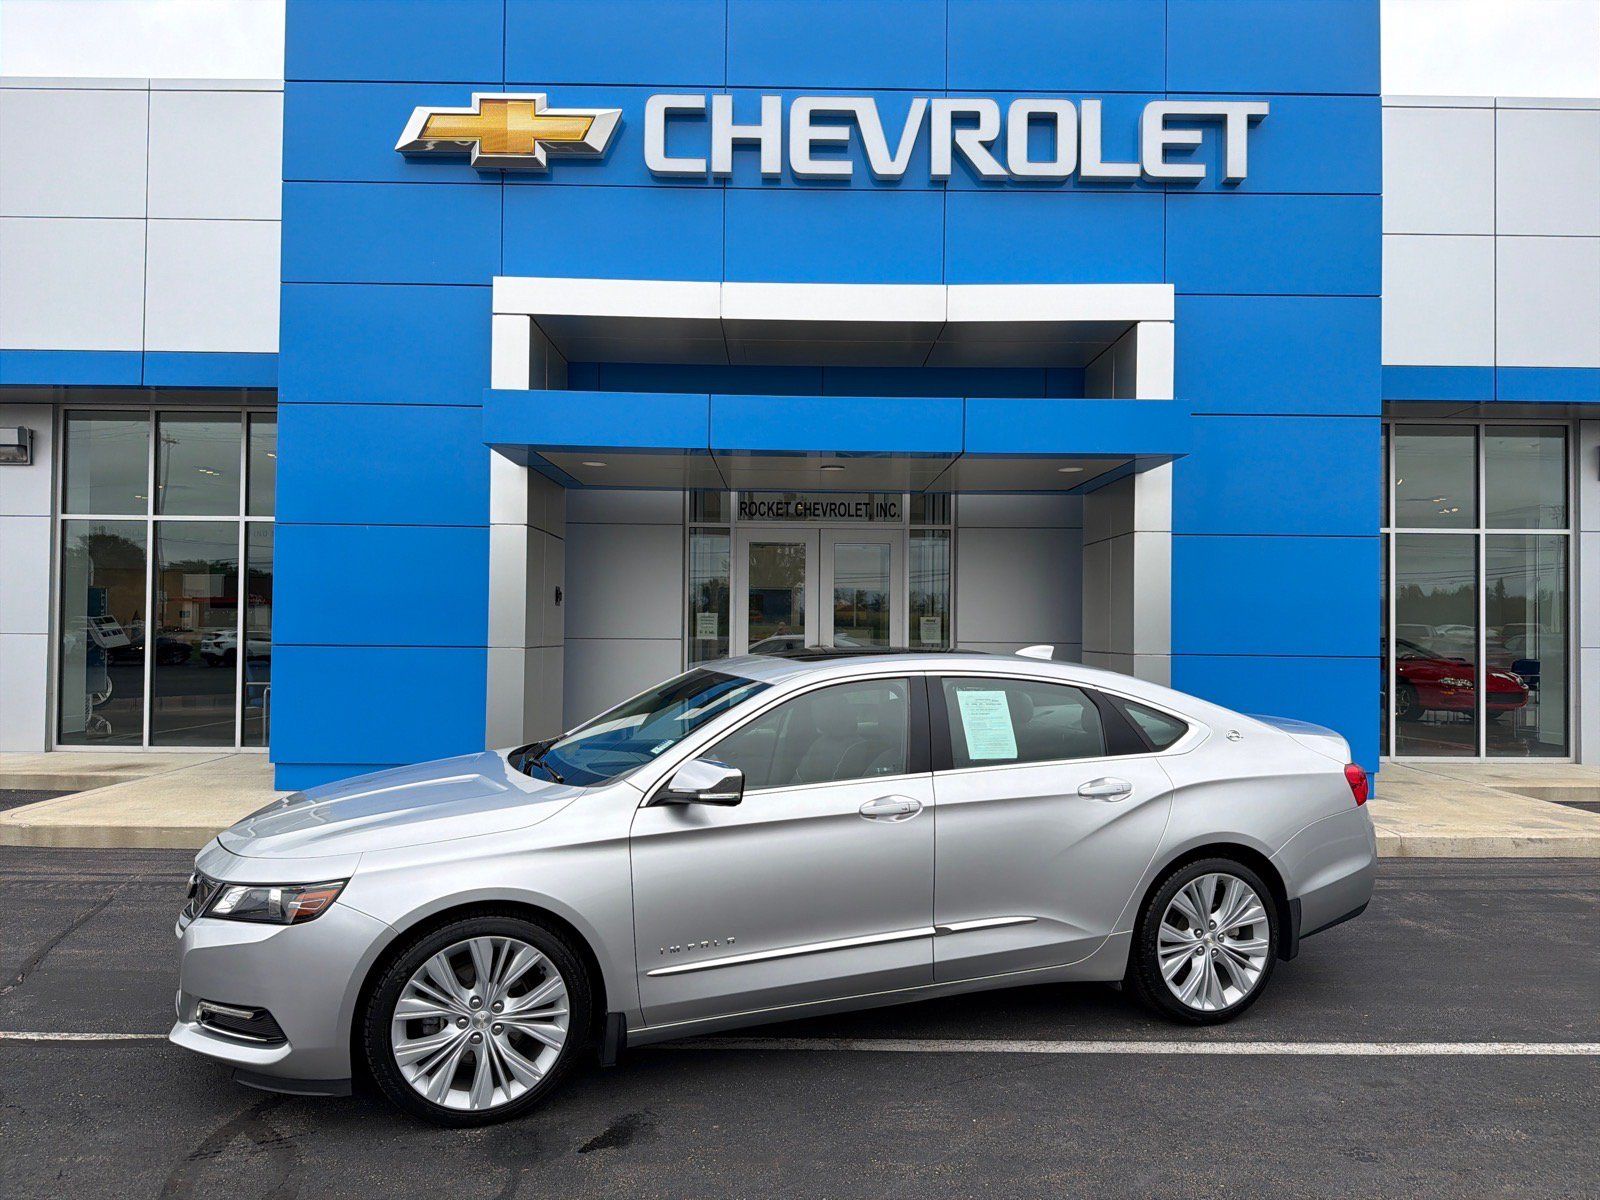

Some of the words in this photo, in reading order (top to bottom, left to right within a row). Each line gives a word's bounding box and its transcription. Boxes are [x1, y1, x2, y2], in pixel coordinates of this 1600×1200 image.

[643, 93, 1270, 184] CHEVROLET
[739, 501, 791, 517] ROCKET
[795, 502, 872, 520] CHEVROLET,
[876, 502, 900, 518] INC.
